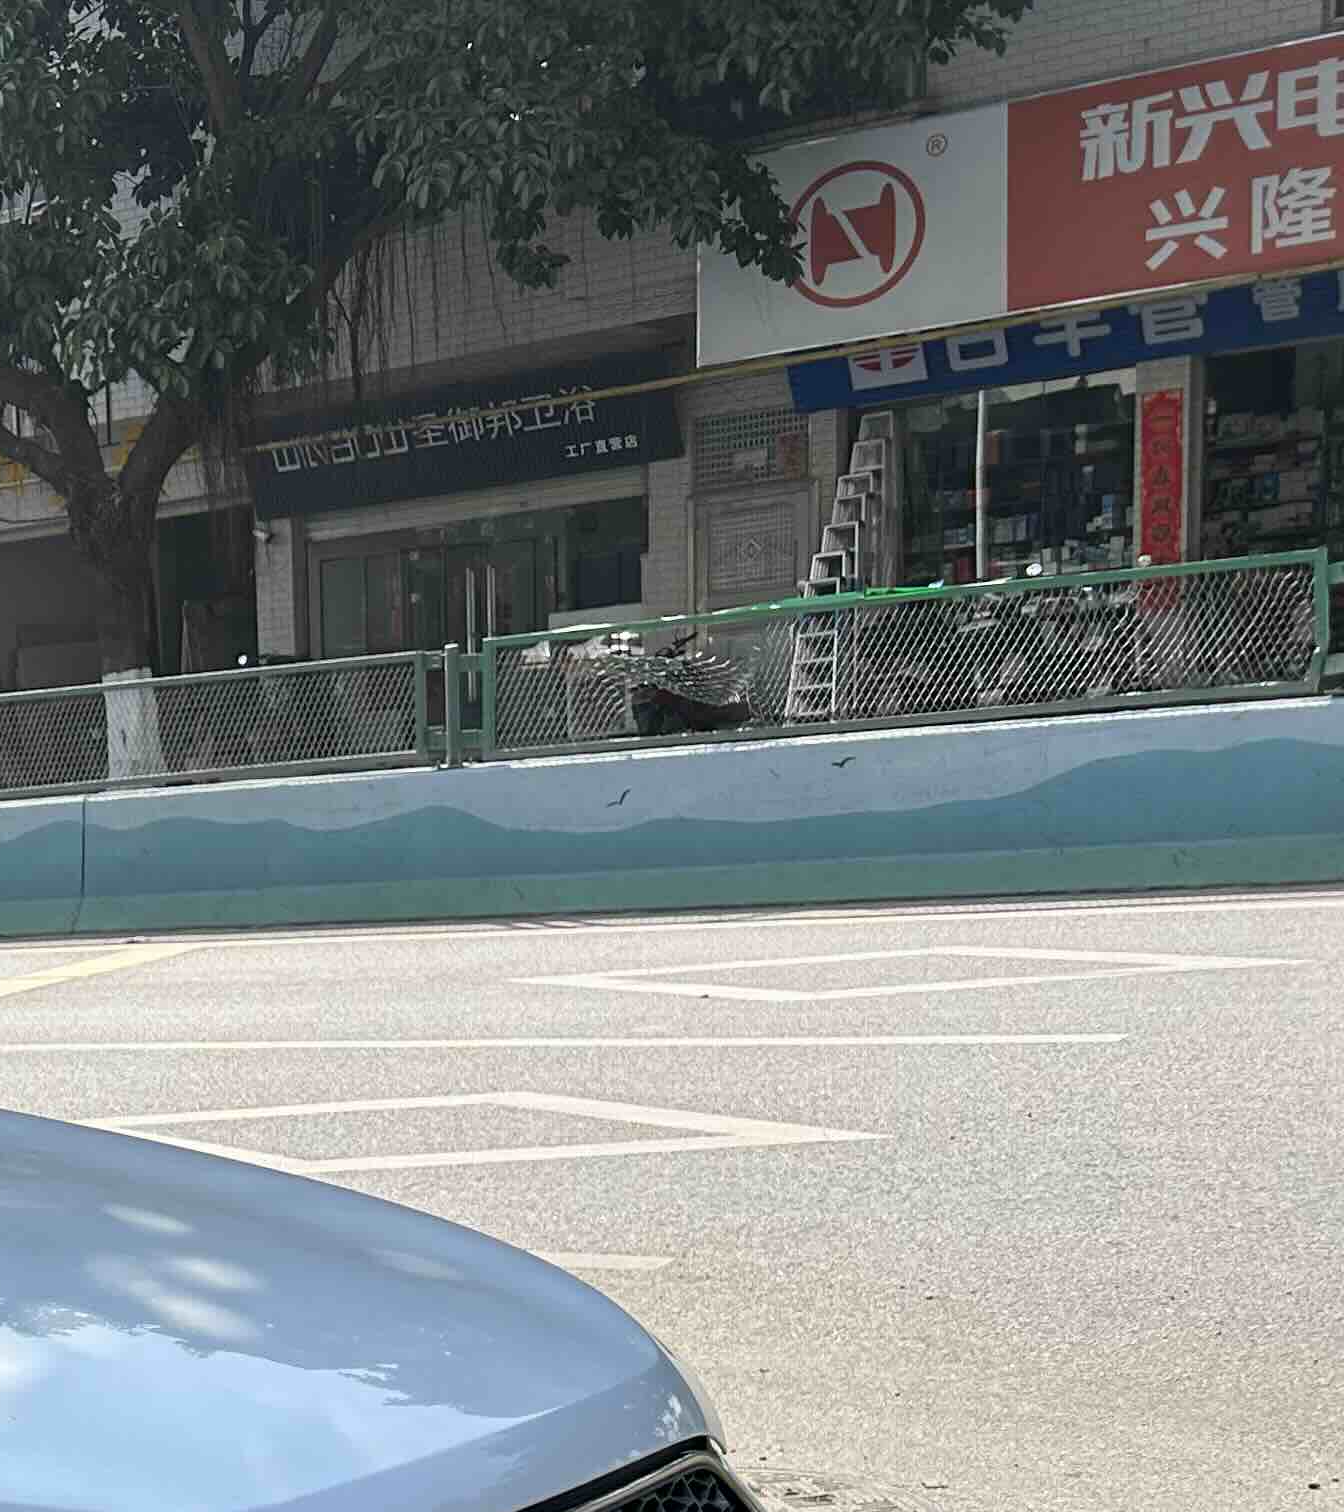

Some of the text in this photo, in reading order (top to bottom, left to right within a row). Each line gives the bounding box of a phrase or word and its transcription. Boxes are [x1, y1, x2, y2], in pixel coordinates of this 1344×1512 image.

[1079, 57, 1344, 181] 新兴电
[1144, 166, 1336, 271] 兴隆
[564, 434, 638, 458] 工厂直营店
